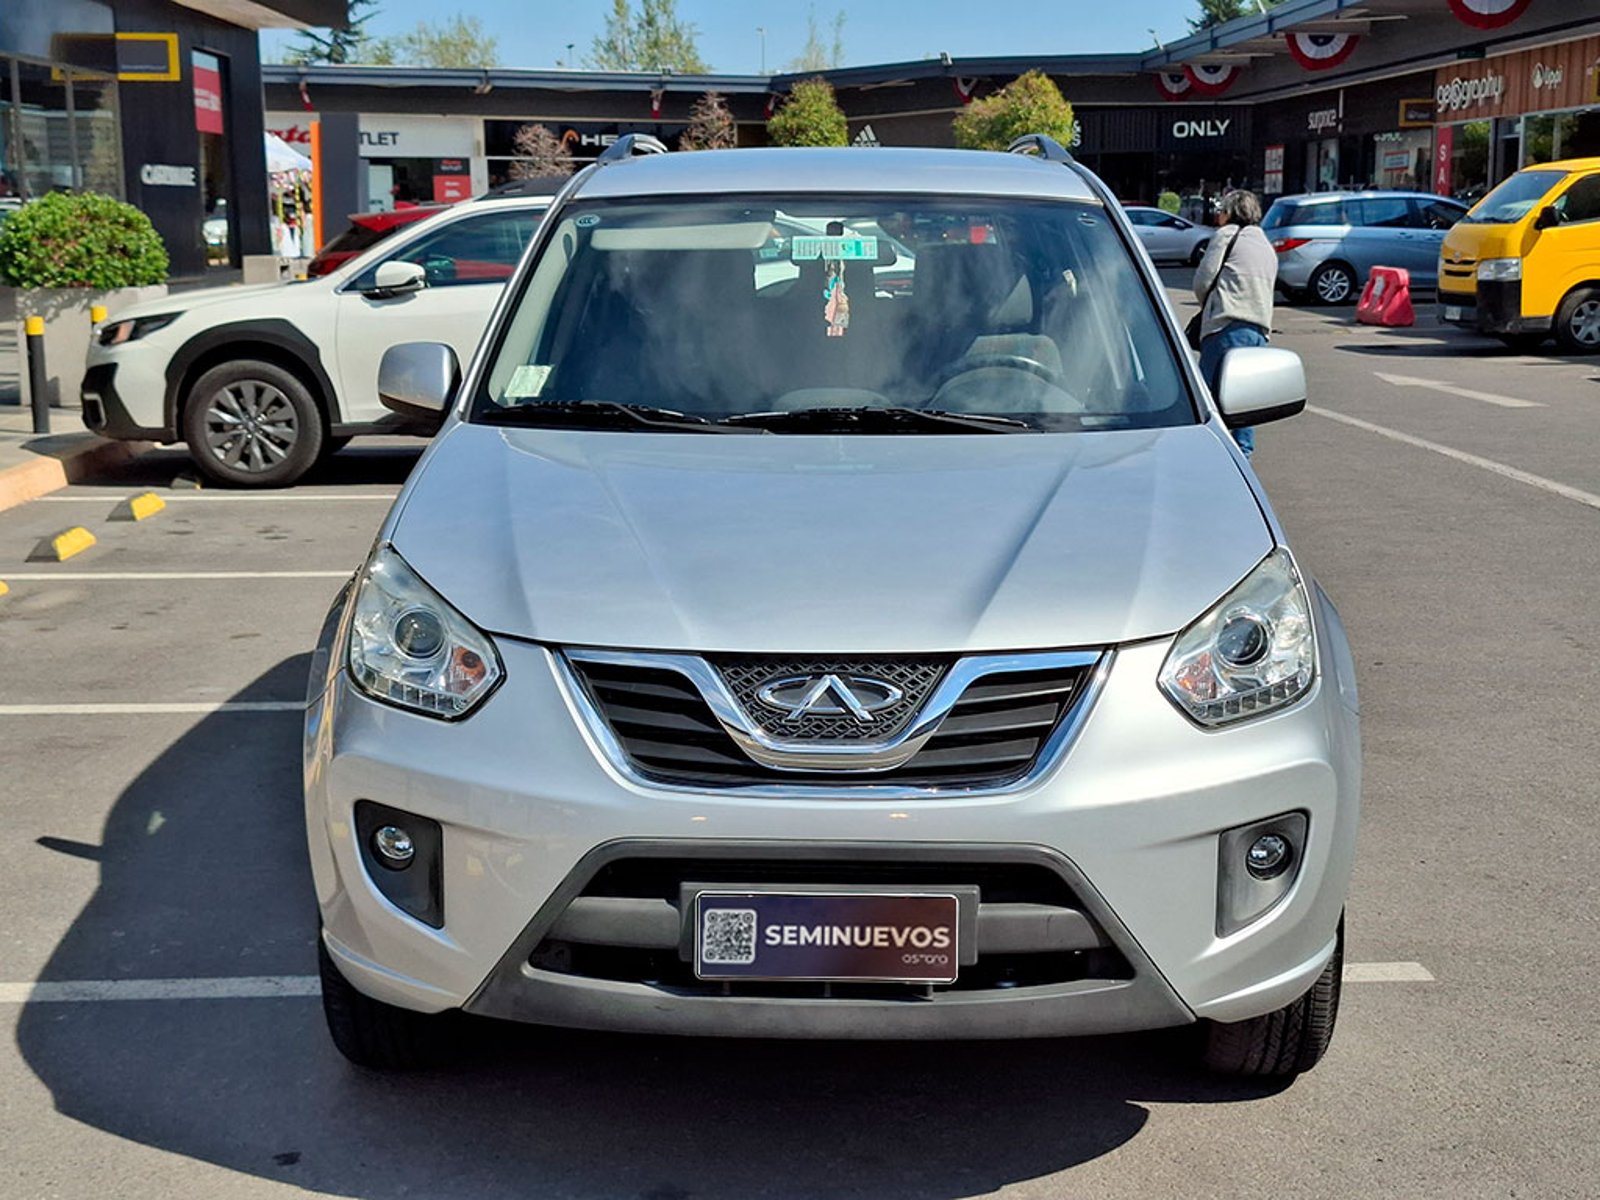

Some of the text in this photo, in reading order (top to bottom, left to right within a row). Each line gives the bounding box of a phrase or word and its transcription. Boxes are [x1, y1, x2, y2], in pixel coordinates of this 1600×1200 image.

[1172, 119, 1231, 139] ONLY
[358, 131, 400, 146] TLET
[581, 133, 619, 147] HE
[764, 925, 950, 949] SEMINUEVOS
